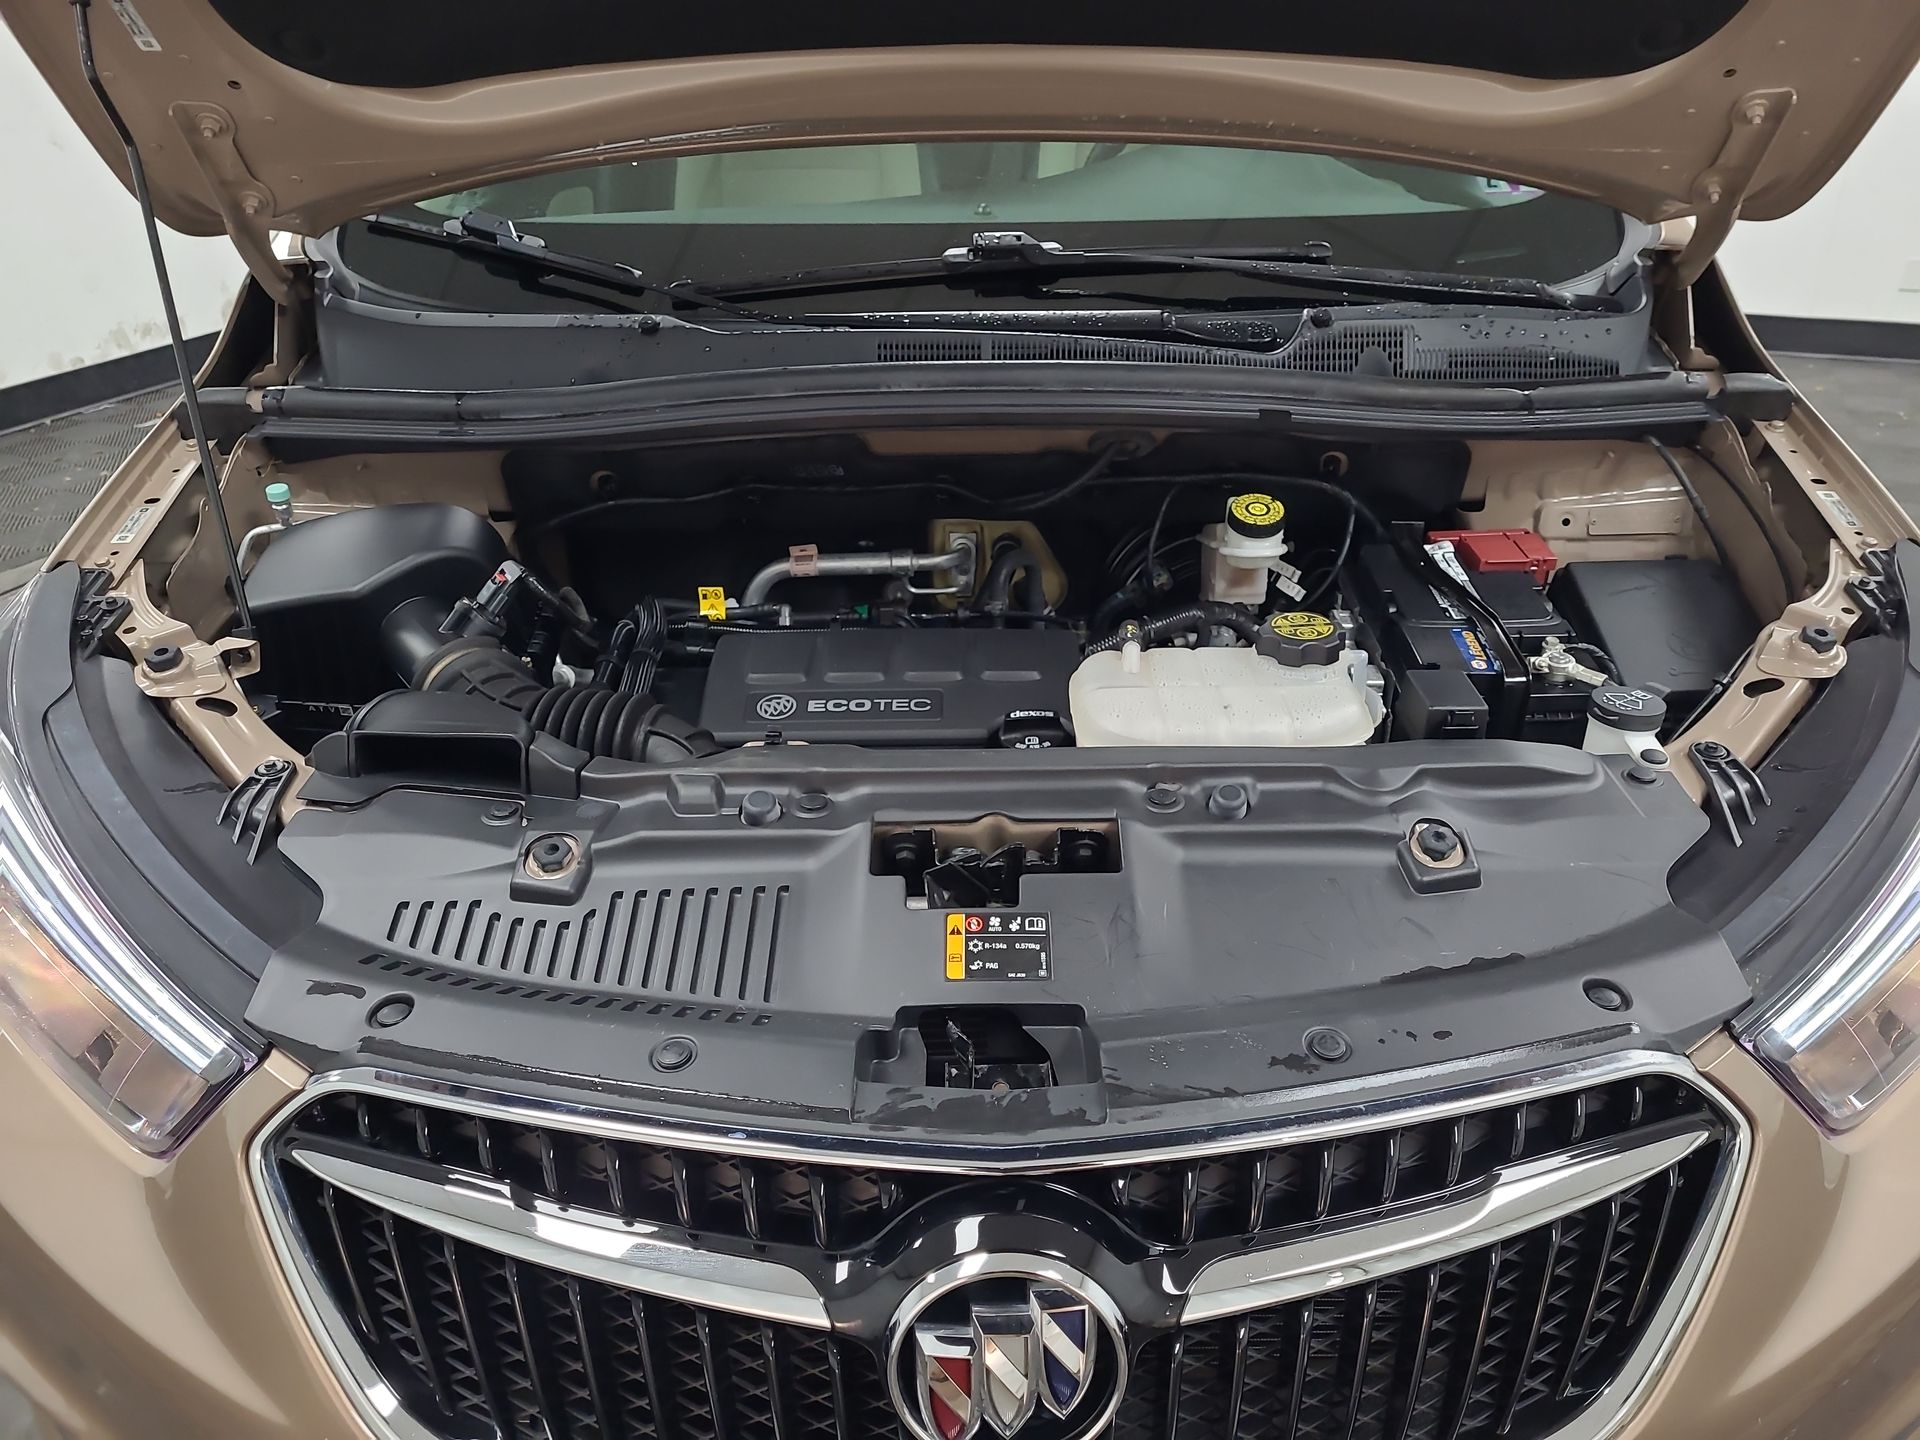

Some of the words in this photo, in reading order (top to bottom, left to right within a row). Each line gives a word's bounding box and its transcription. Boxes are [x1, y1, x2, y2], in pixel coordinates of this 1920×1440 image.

[1461, 630, 1488, 661] LEGEND
[807, 699, 932, 712] ECOTEC
[1010, 710, 1054, 718] dexos
